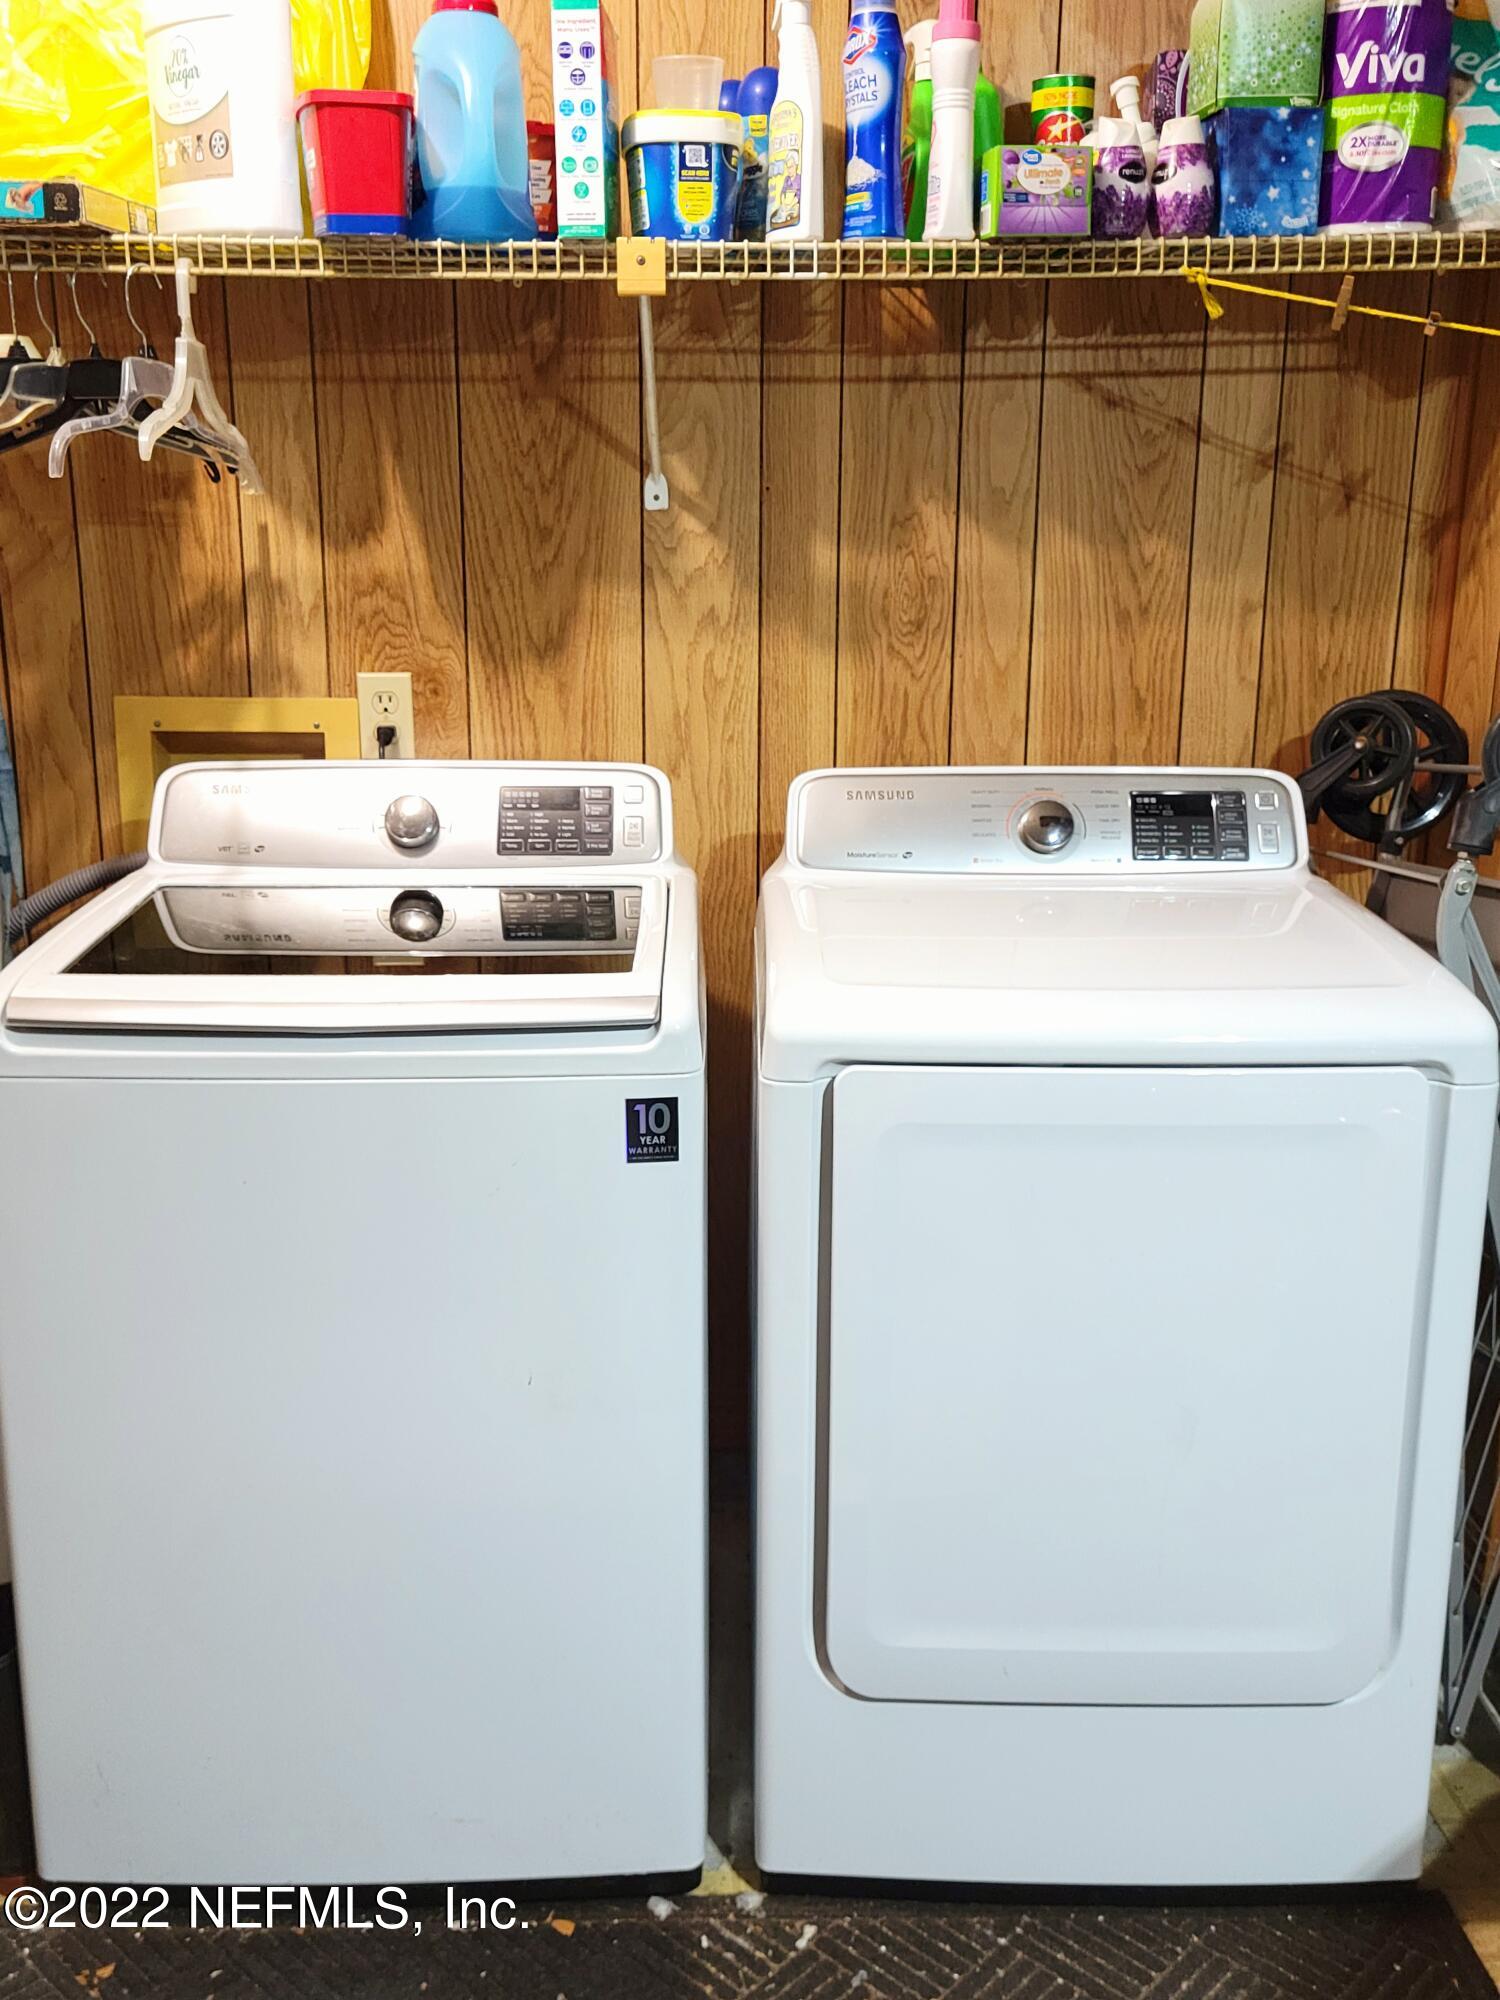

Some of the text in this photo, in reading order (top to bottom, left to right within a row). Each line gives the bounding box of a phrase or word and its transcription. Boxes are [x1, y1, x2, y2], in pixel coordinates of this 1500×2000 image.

[1336, 40, 1425, 88] Viva
[164, 65, 200, 89] Vinegar
[845, 74, 877, 95] LEACH
[1351, 137, 1367, 148] 2X
[846, 790, 914, 800] SAMSUNG
[633, 1102, 671, 1134] 10
[640, 1135, 666, 1145] YEAR
[628, 1145, 677, 1155] WARRANTY
